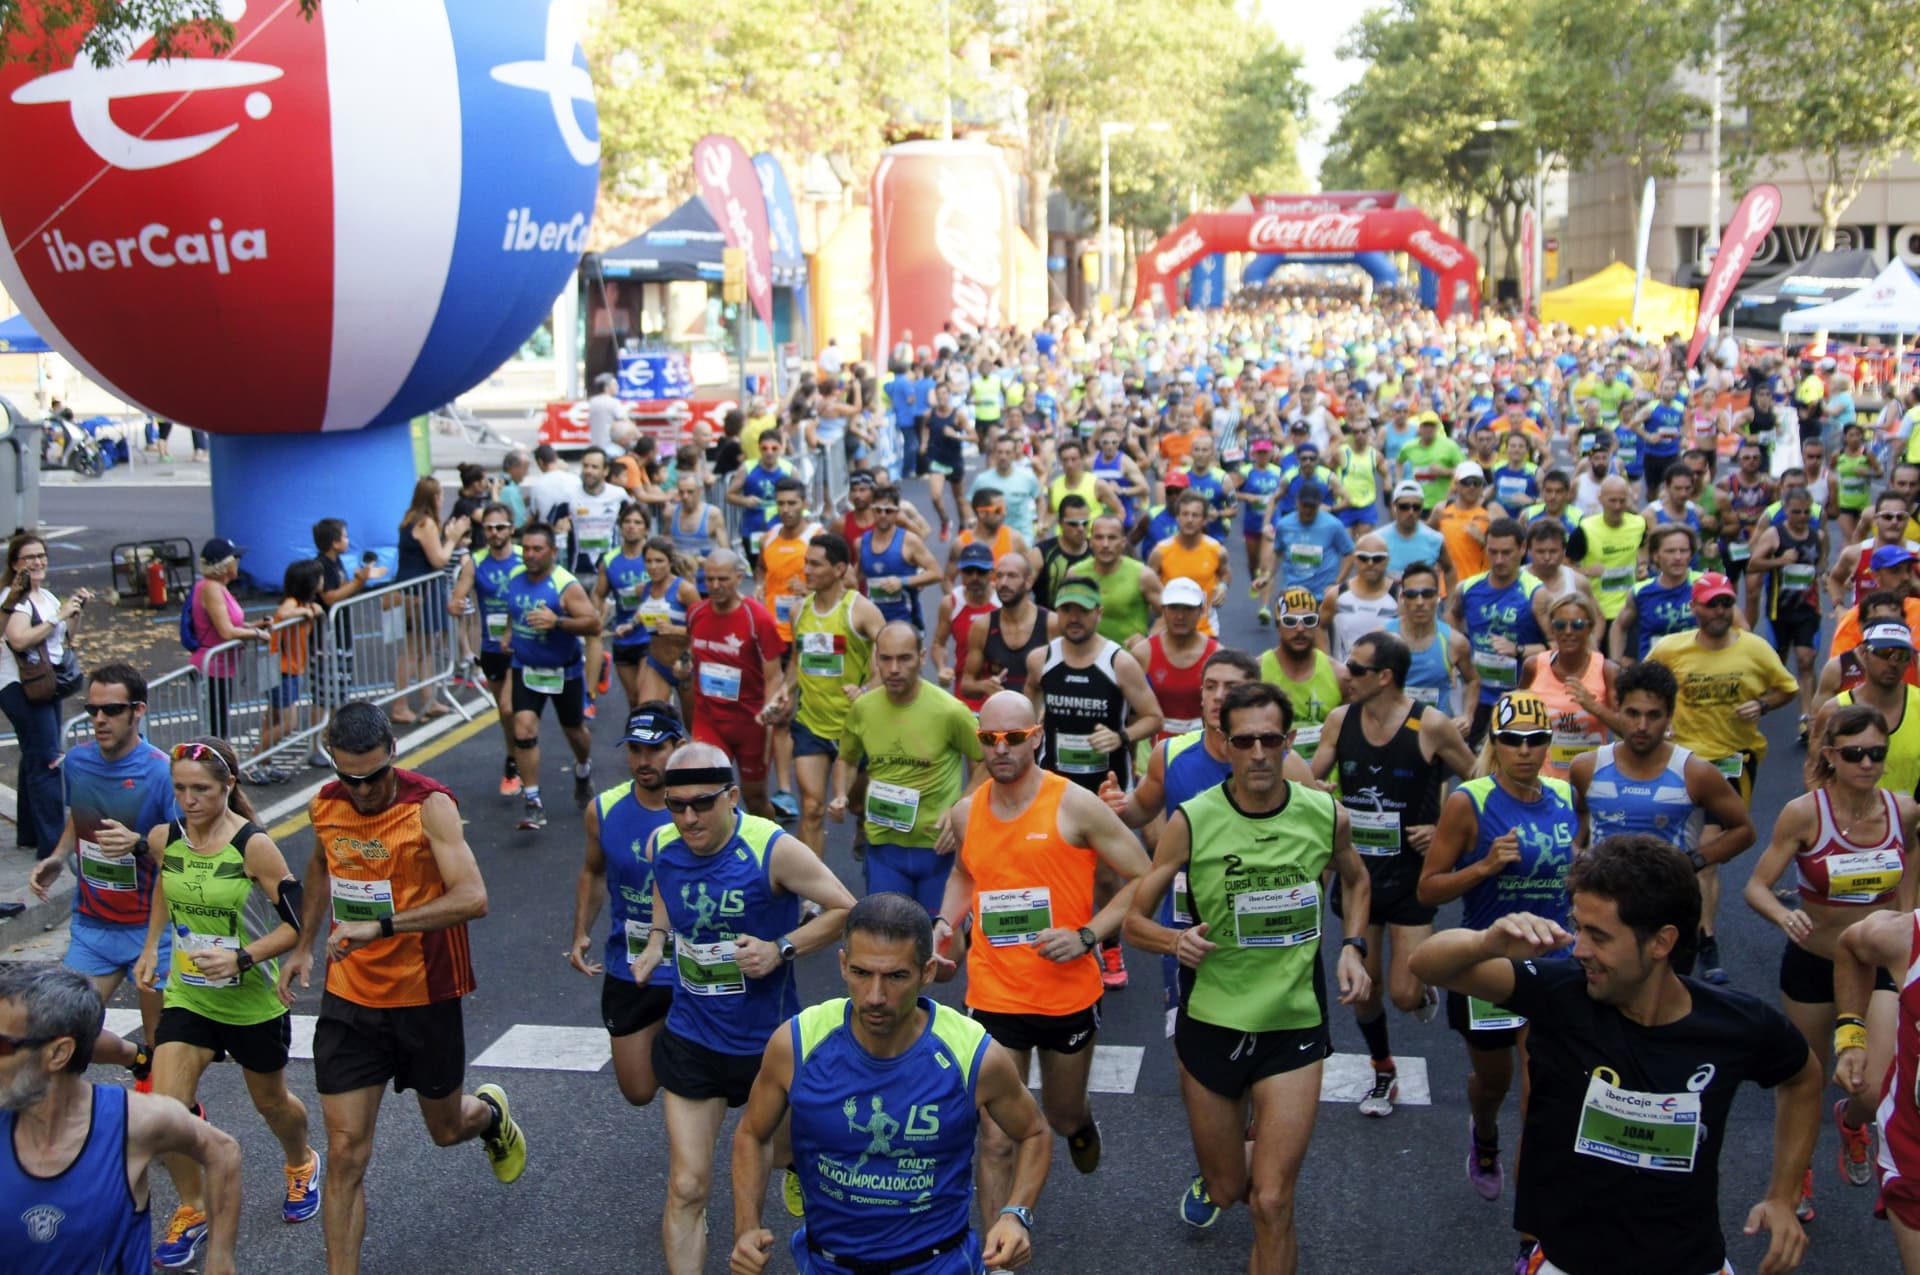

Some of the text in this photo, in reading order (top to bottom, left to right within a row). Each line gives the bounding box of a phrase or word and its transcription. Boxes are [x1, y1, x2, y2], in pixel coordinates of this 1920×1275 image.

[1250, 213, 1366, 249] Coca-Cola
[42, 217, 267, 274] iberCaja
[1046, 694, 1108, 710] RUNNERS
[1554, 822, 1573, 844] LS
[1224, 871, 1309, 892] CURSA DE MUNTAN
[719, 889, 755, 913] LS
[1605, 1088, 1652, 1109] iberCaja
[905, 1104, 940, 1135] LS
[1622, 1125, 1655, 1141] JOAN
[898, 1158, 936, 1170] KNLTS
[818, 1161, 934, 1191] VILAOLIMPICA10K.COM
